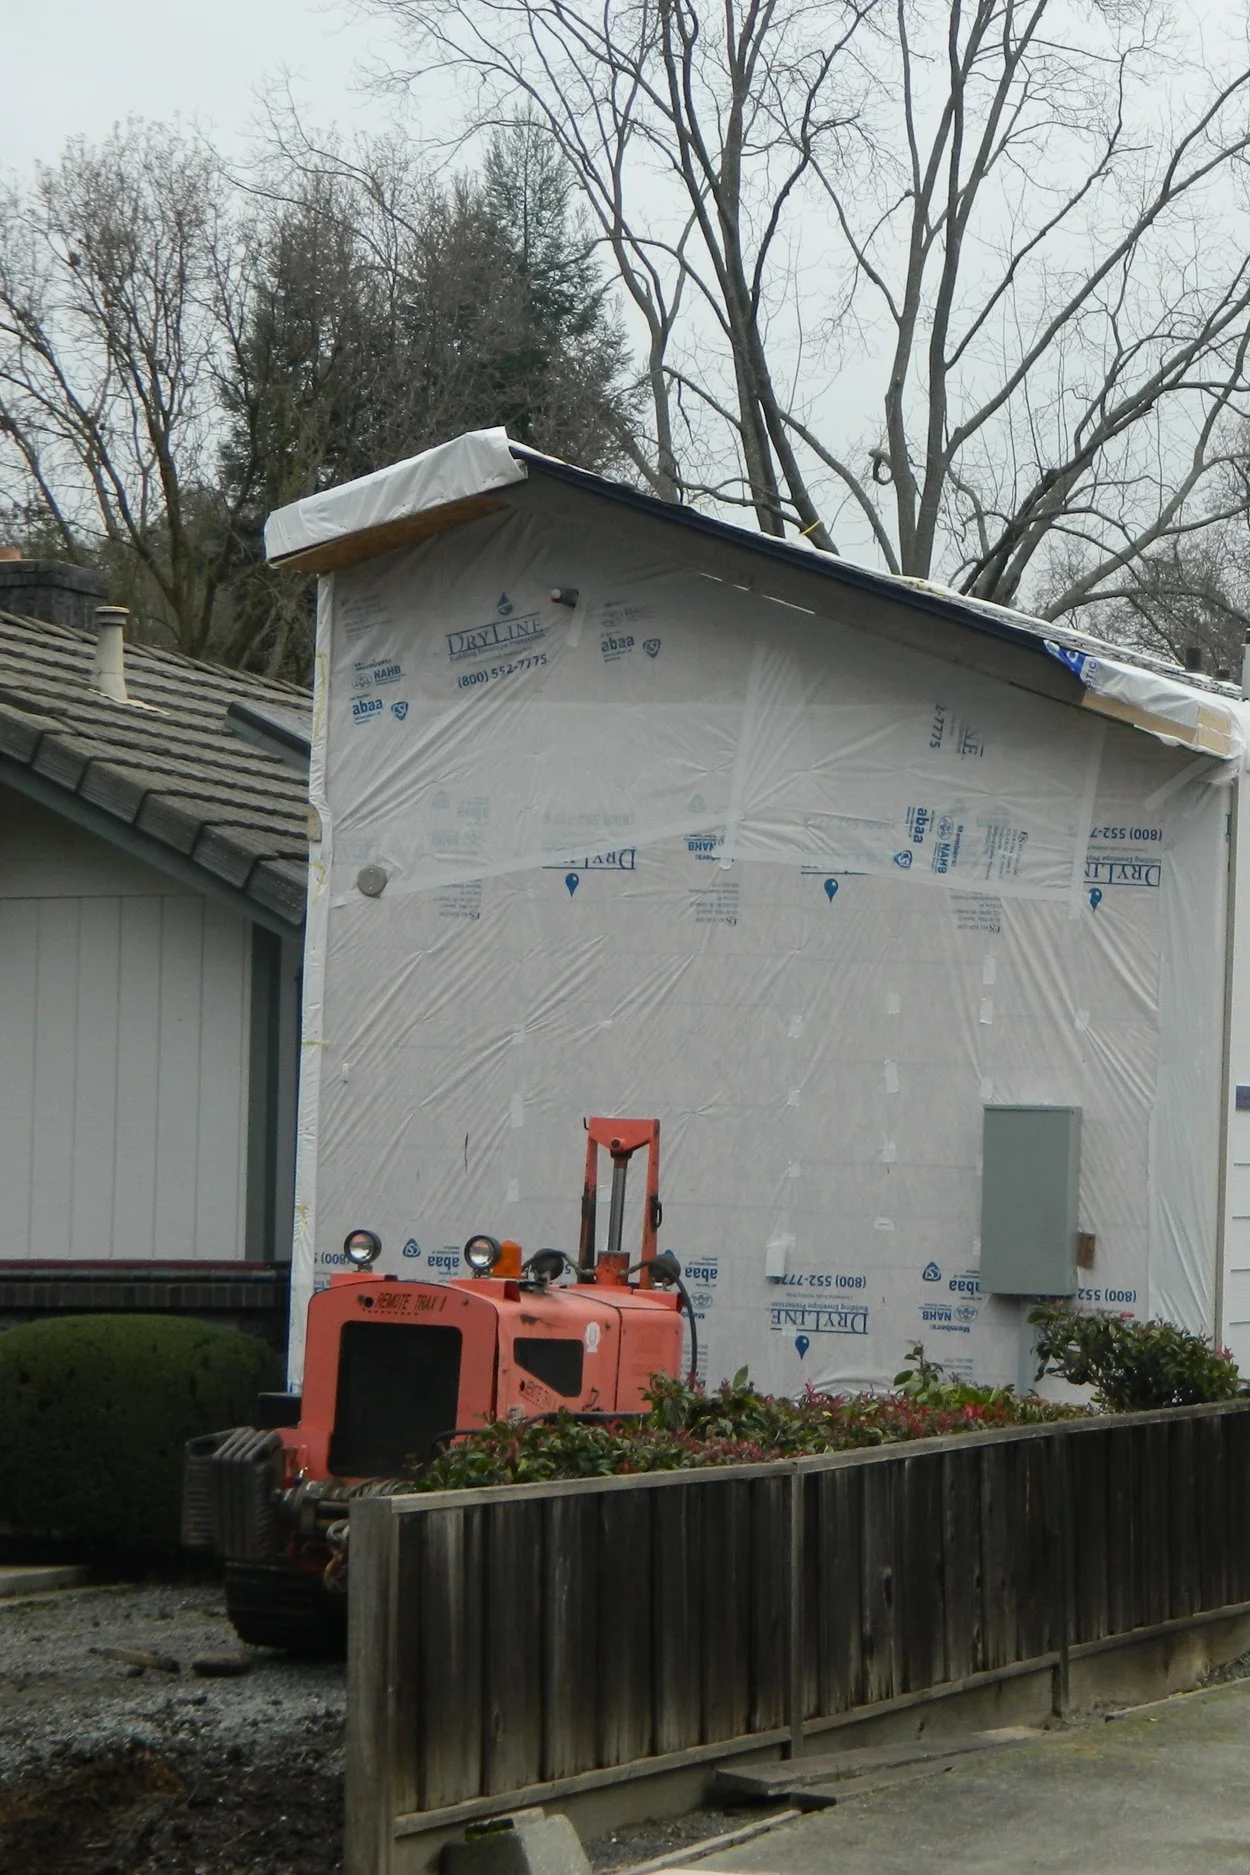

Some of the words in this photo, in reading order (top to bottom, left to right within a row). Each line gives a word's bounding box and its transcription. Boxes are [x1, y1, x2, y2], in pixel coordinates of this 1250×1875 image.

[600, 635, 635, 653] abaa
[374, 665, 402, 680] NAHB
[457, 671, 489, 689] (800)
[491, 653, 548, 679] 552-7775
[352, 699, 384, 716] abaa
[912, 807, 930, 844] abaa
[1089, 827, 1126, 839] 552-7
[1129, 827, 1163, 841] (800)
[937, 842, 952, 874] NAHB
[427, 1256, 460, 1271] abaa
[684, 1267, 718, 1283] abaa
[835, 1274, 867, 1289] (800)
[376, 1292, 412, 1310] REMOTE
[1104, 1288, 1137, 1303] (800)
[922, 1310, 952, 1321] NAHB
[929, 1323, 970, 1333] Members:
